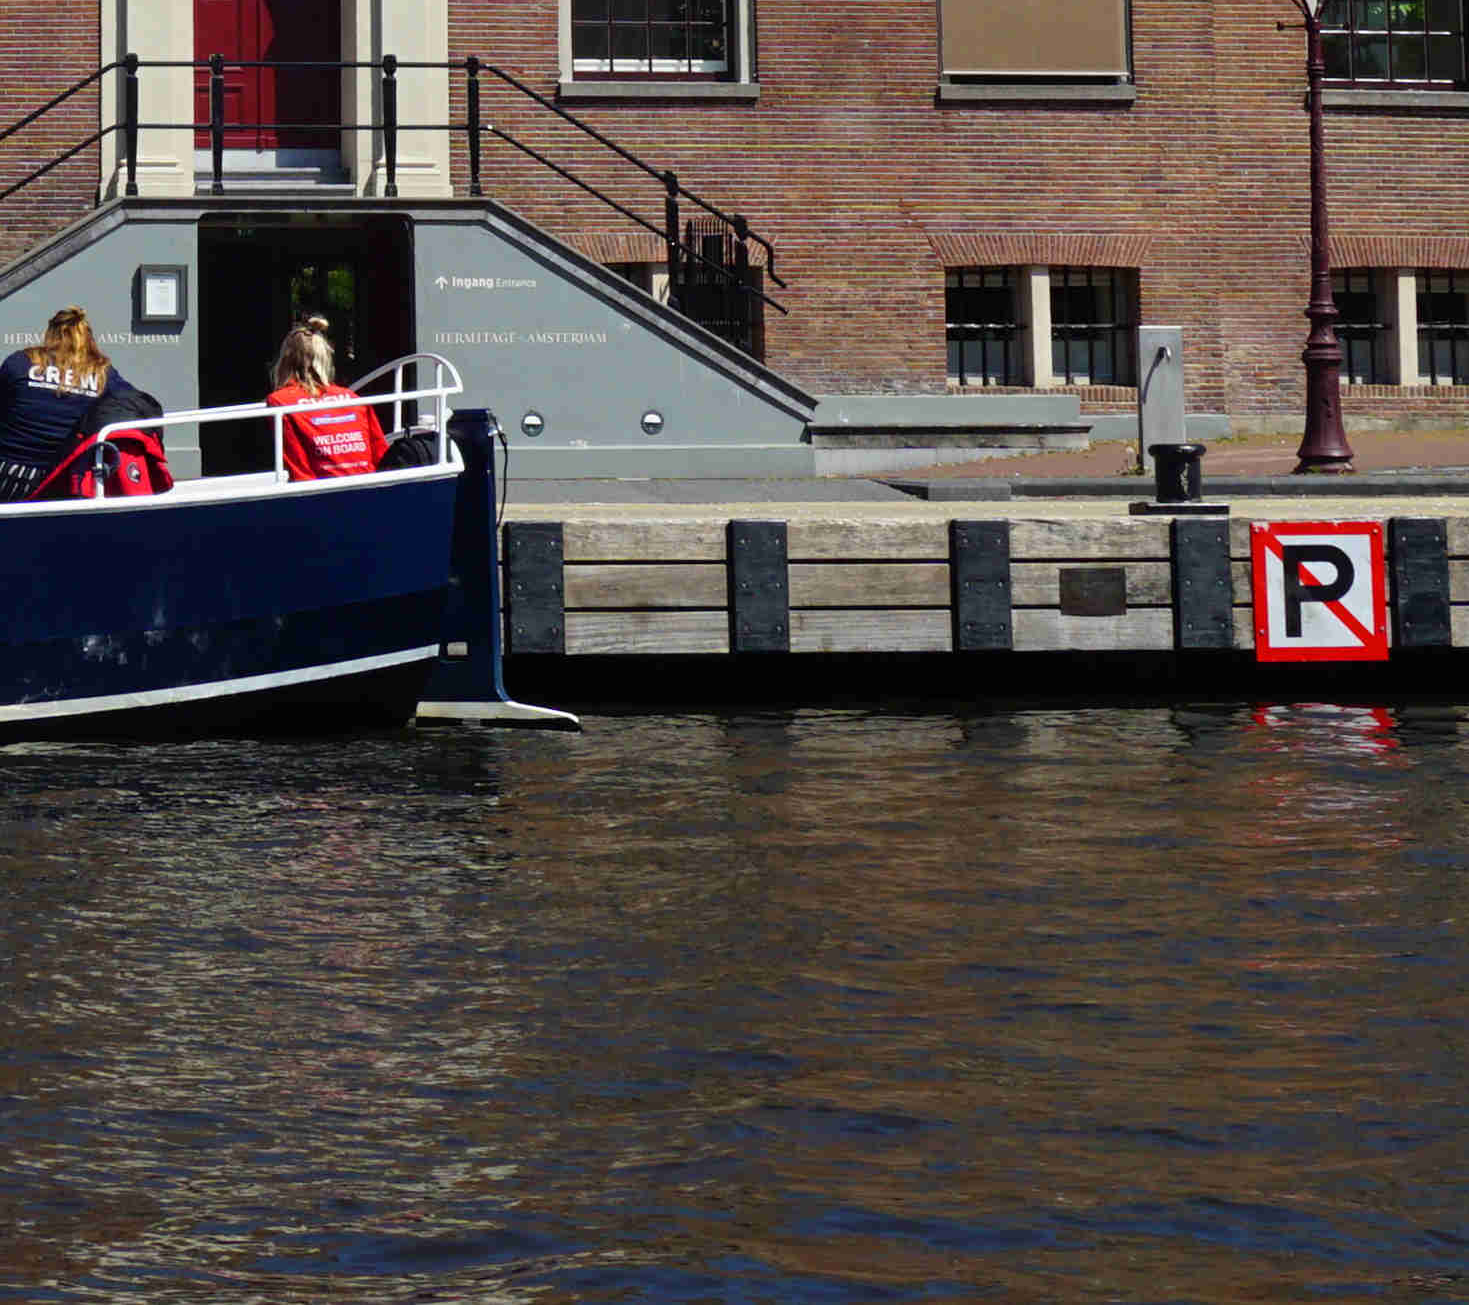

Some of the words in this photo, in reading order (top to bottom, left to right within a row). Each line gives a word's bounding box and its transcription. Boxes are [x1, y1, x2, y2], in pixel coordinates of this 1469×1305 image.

[452, 275, 495, 289] Ingang
[496, 277, 537, 288] Entrance
[98, 333, 181, 344] AMSTERDAM
[434, 332, 516, 344] HERMITAGE
[527, 332, 608, 344] AMSTERDAM
[27, 364, 100, 392] CREW
[313, 431, 363, 446] WELCOME
[333, 441, 367, 455] BOARD
[1282, 543, 1355, 639] P
